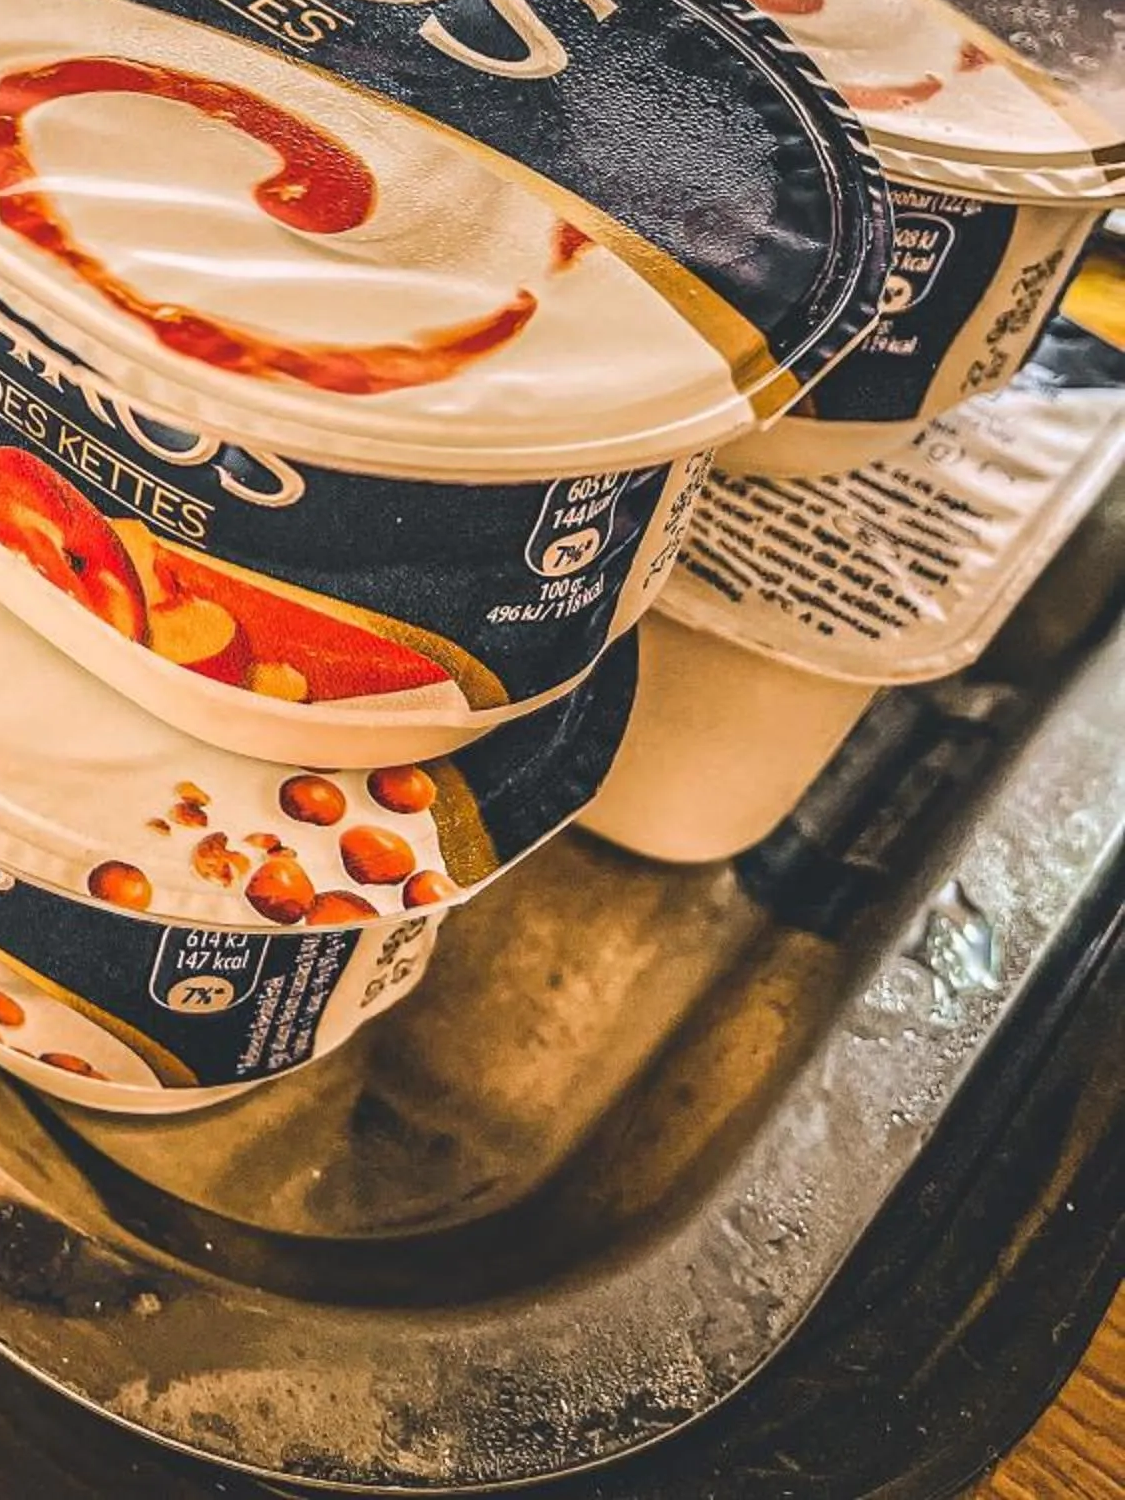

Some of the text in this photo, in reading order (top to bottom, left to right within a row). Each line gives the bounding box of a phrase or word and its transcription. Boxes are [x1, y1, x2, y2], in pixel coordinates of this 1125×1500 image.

[58, 424, 208, 538] KETTES
[552, 502, 588, 530] 144
[538, 577, 570, 601] 100
[486, 603, 523, 624] 496
[185, 928, 222, 949] 614
[176, 948, 251, 971] 147 kcal
